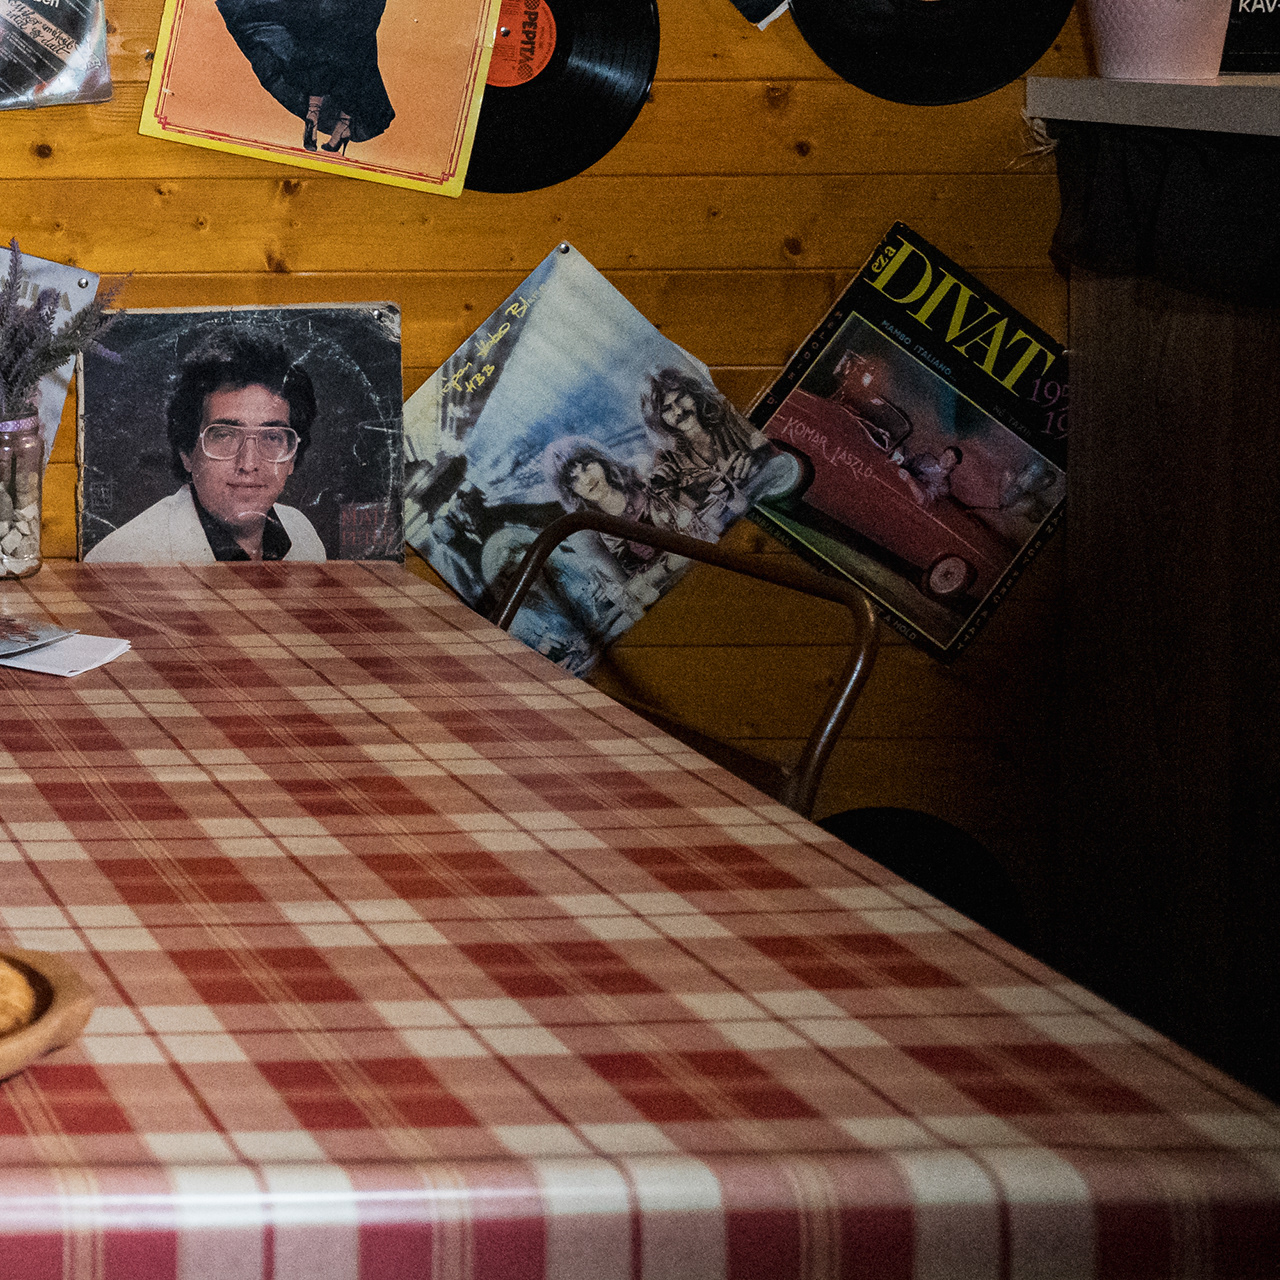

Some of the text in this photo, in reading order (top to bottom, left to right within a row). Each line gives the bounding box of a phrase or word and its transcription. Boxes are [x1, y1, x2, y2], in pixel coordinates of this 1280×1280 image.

[519, 9, 537, 62] PEPITA
[863, 235, 1056, 397] DIVAT
[882, 320, 912, 345] MAMBO
